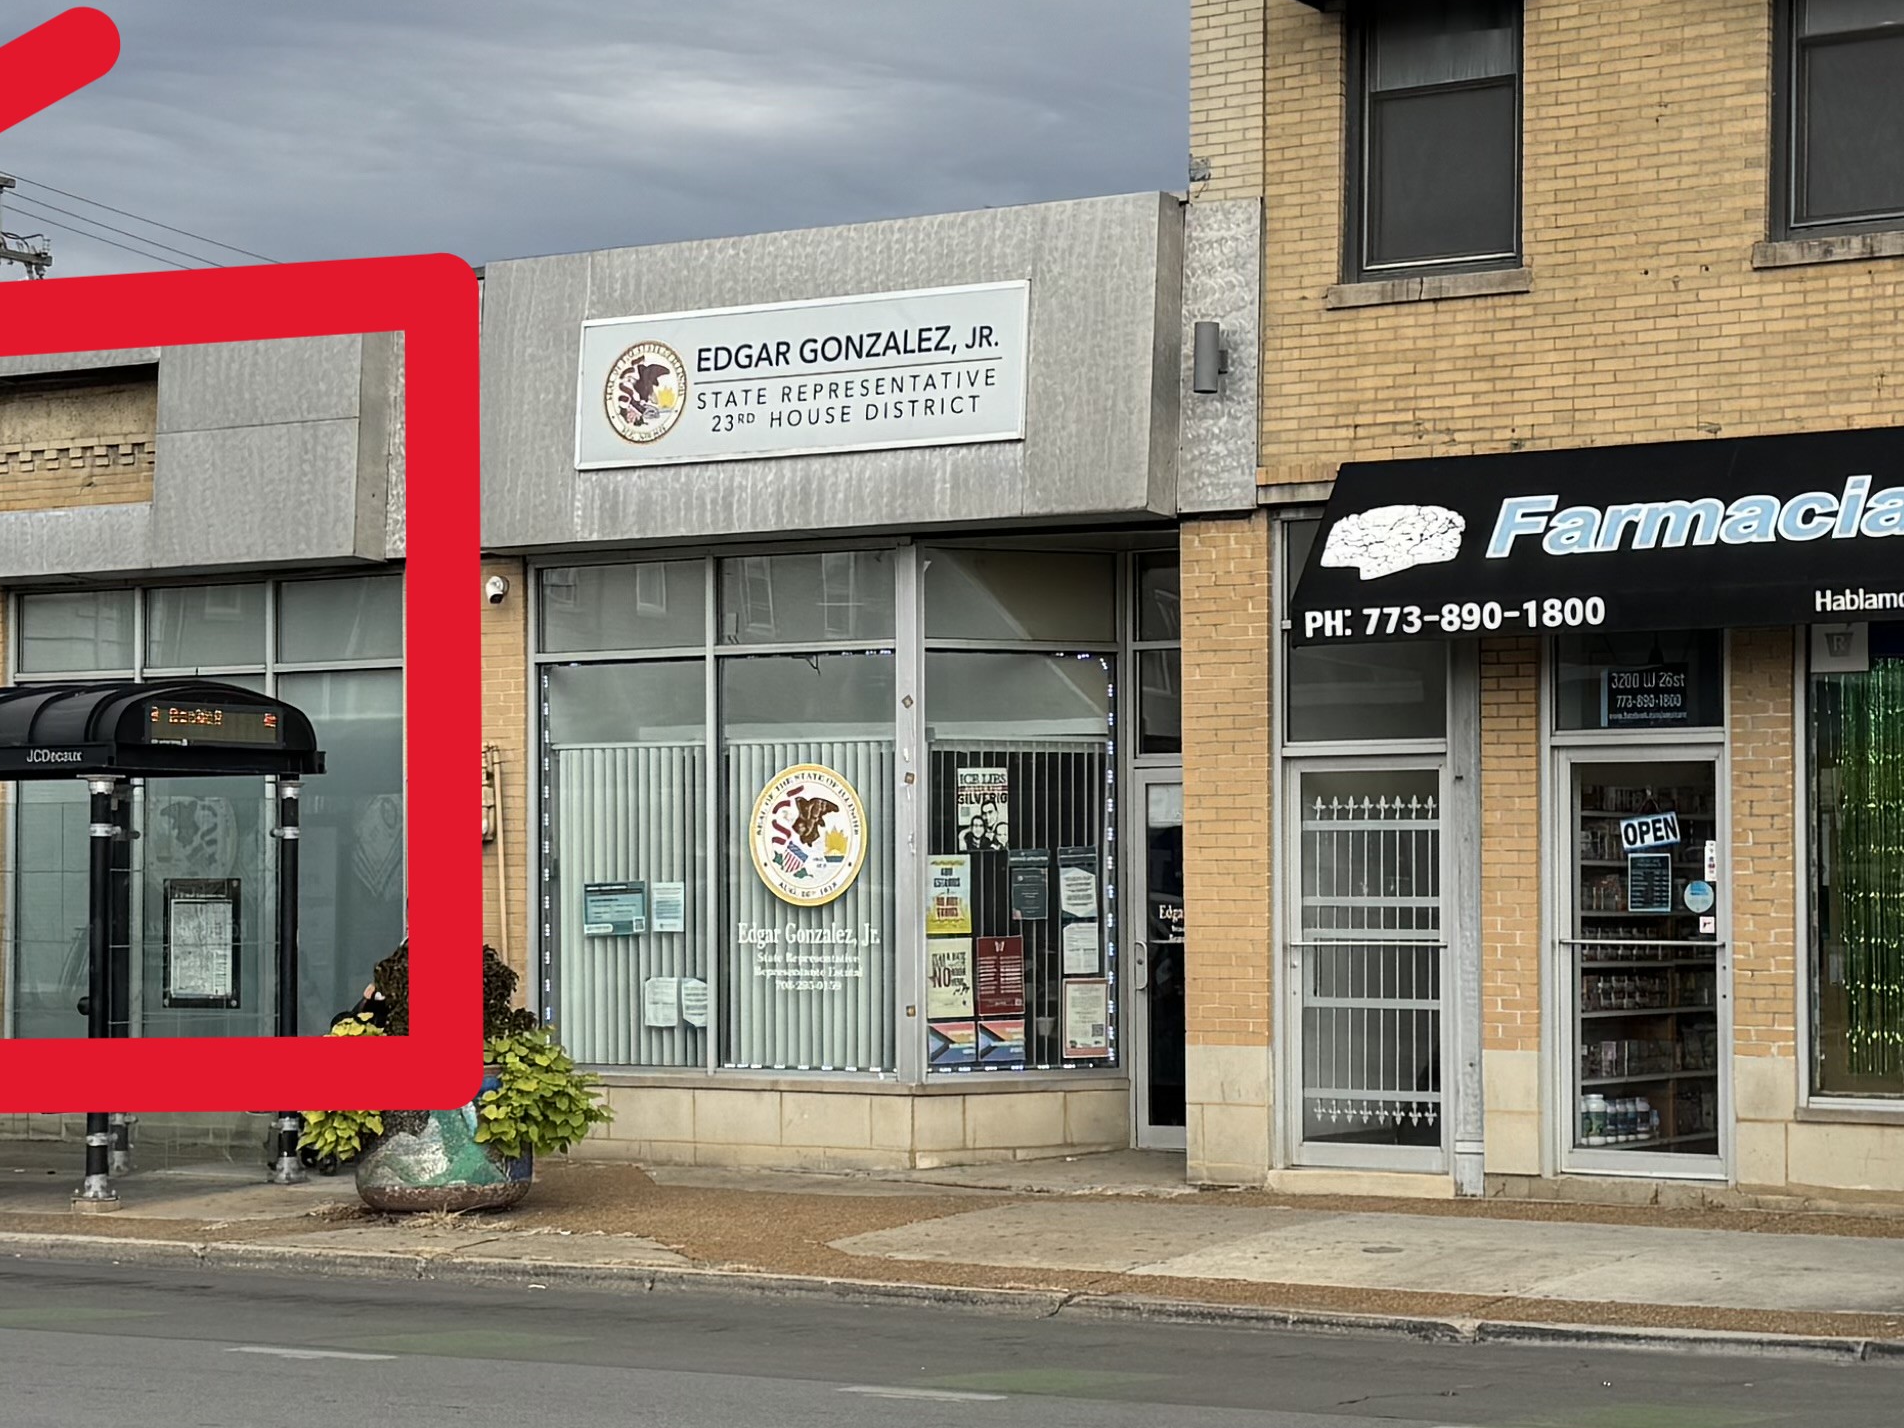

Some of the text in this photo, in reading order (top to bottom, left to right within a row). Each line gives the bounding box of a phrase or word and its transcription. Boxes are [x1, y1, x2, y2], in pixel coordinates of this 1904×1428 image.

[696, 325, 1000, 372] EDGAR GONZALEZ, JR.
[697, 368, 997, 411] STATE REPRESENTATIVE
[711, 395, 982, 433] 23RD HOUSE DISTRICT
[1304, 595, 1607, 639] PH: 773-890-1800
[1611, 673, 1639, 689] 3200
[1622, 815, 1679, 847] OPEN
[738, 922, 881, 950] Edgar Gonzalez, Jr.
